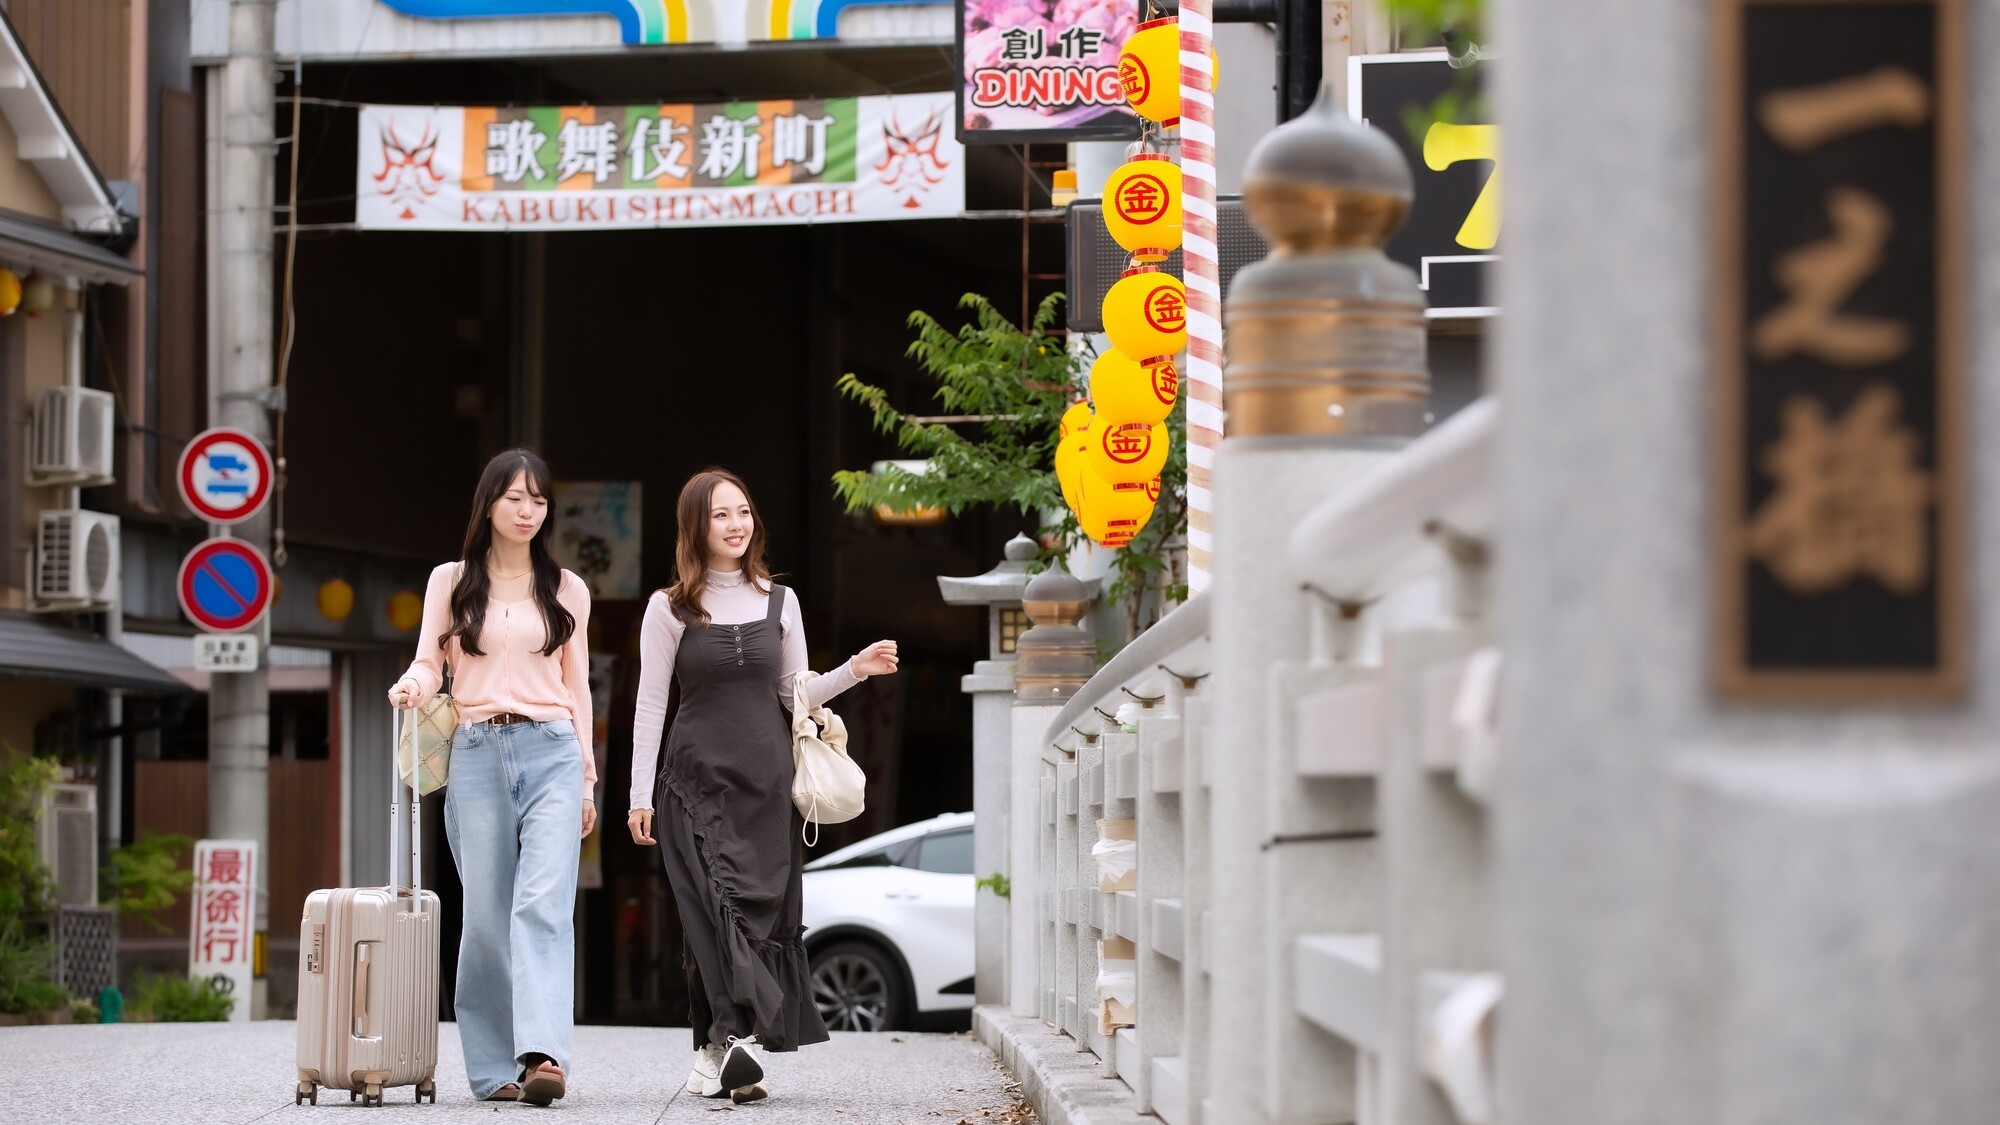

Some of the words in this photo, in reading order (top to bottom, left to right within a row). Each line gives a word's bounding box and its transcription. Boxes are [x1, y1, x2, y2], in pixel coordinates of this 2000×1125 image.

[1001, 28, 1103, 60] 創作
[975, 70, 1124, 105] DINING
[485, 113, 836, 183] 歌舞伎新町
[461, 195, 616, 224] KABUKI
[627, 188, 856, 221] SHINMACHI
[1124, 181, 1158, 213] 金
[1154, 292, 1185, 323] 金
[1159, 364, 1178, 396] 金
[204, 850, 242, 963] 最徐行
